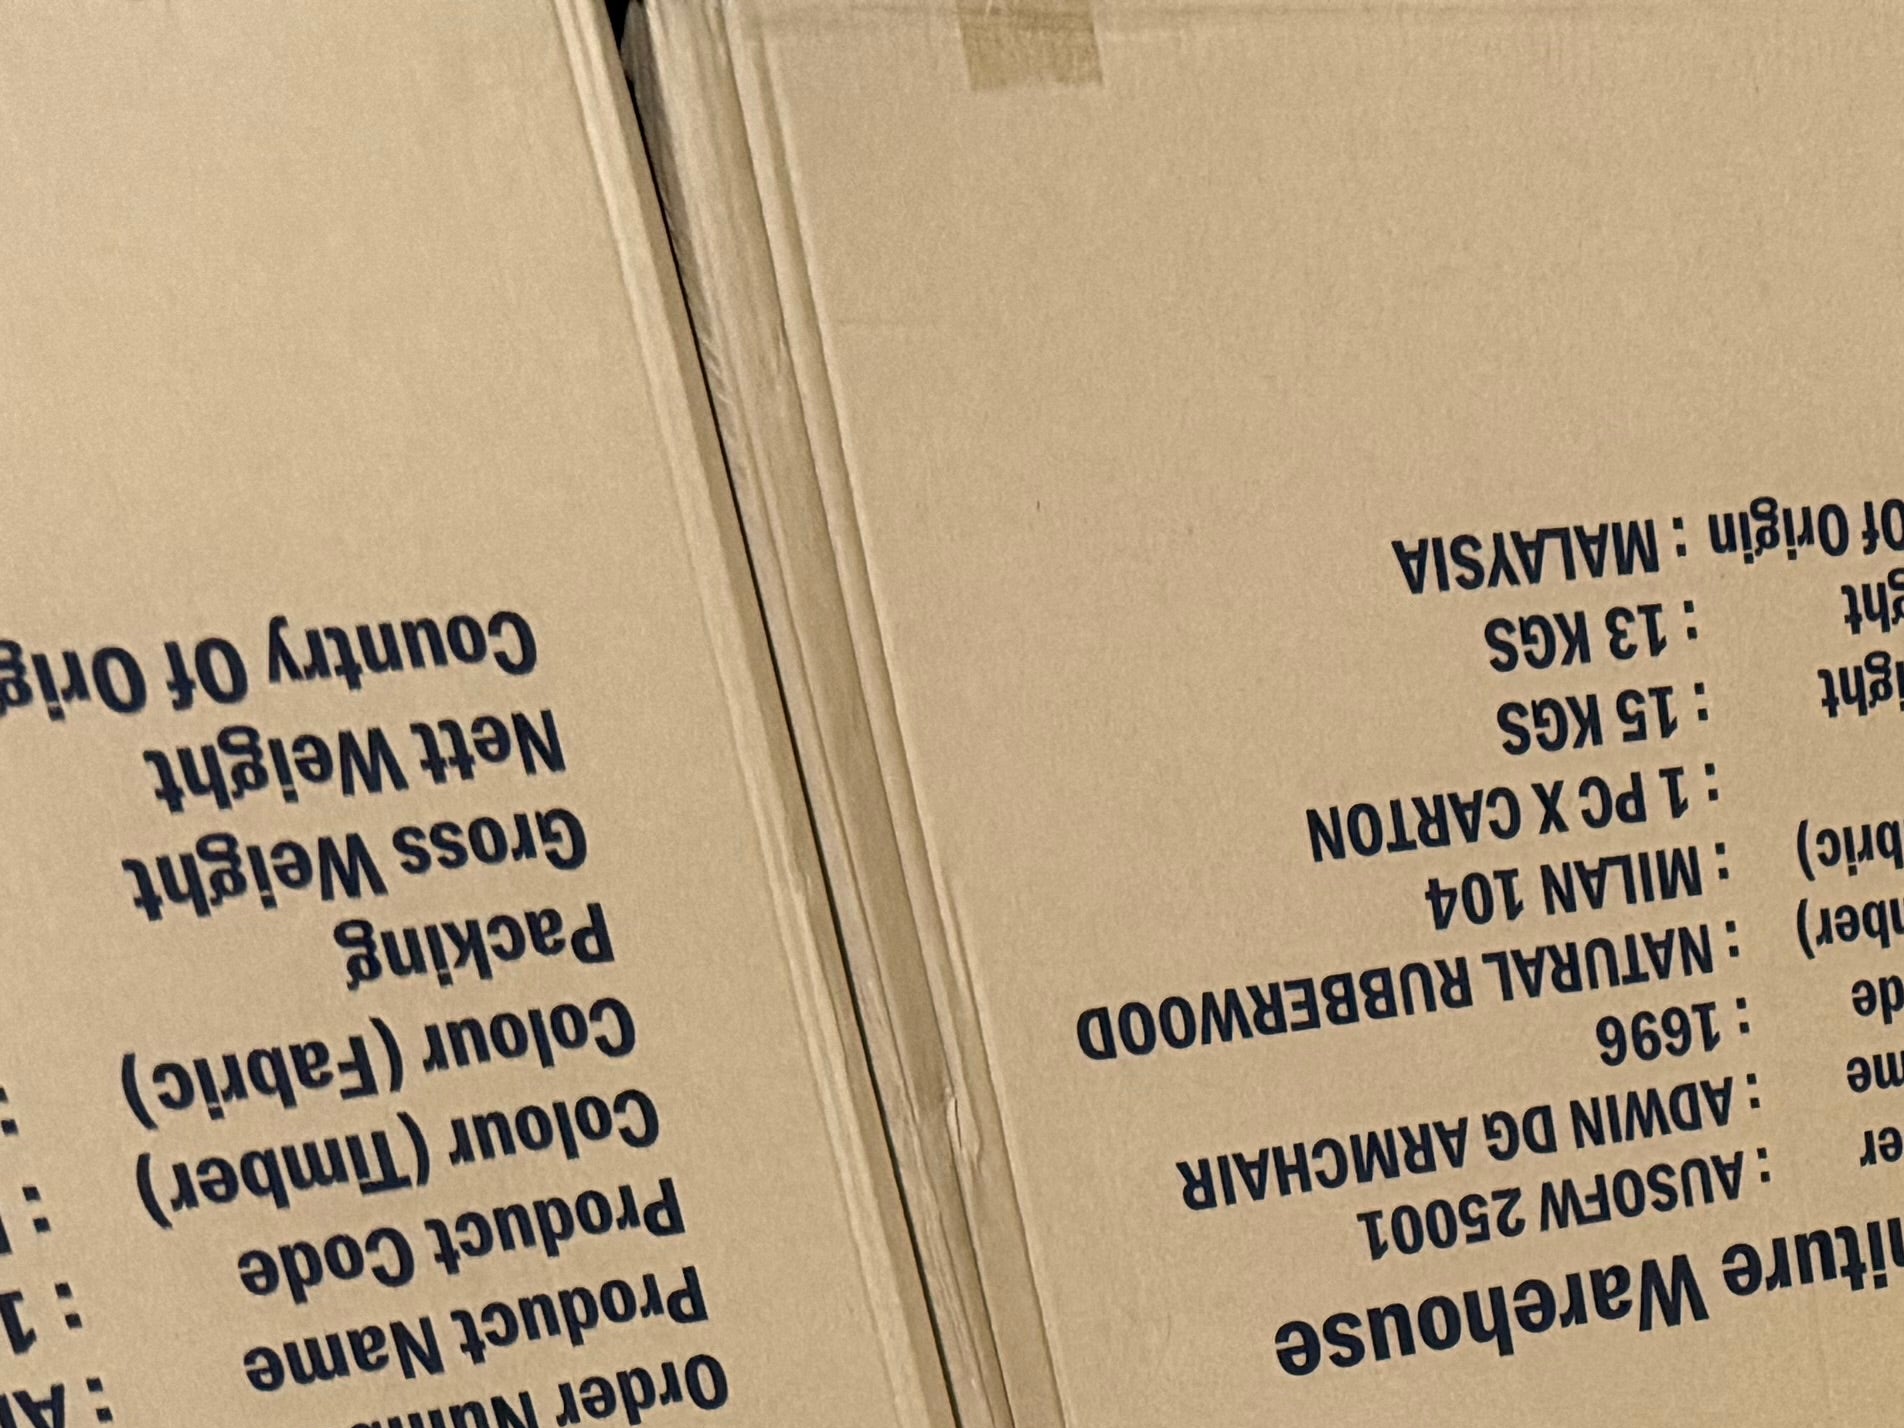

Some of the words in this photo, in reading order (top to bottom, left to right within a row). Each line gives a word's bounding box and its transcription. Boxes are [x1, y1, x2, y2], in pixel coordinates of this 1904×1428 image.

[1390, 518, 1660, 595] MALAYSIA
[1707, 495, 1850, 565] Origin
[163, 636, 249, 712] Of
[268, 610, 538, 691] Country
[142, 724, 410, 814] Weight
[409, 708, 566, 785] Nett
[121, 832, 388, 922] Weight
[391, 807, 587, 875] Gross
[1481, 923, 1714, 1002] NATURAL
[1076, 956, 1474, 1061] RUBBERWOOD
[1595, 1001, 1721, 1067] 1696
[1481, 1104, 1558, 1162] DG
[1569, 1076, 1733, 1149] ADWIN
[1176, 1116, 1468, 1211] ARMCHAIR
[449, 1265, 709, 1365] Product
[1274, 1253, 1710, 1377] Warehouse
[243, 1316, 445, 1392] Name
[555, 1353, 729, 1428] Order
